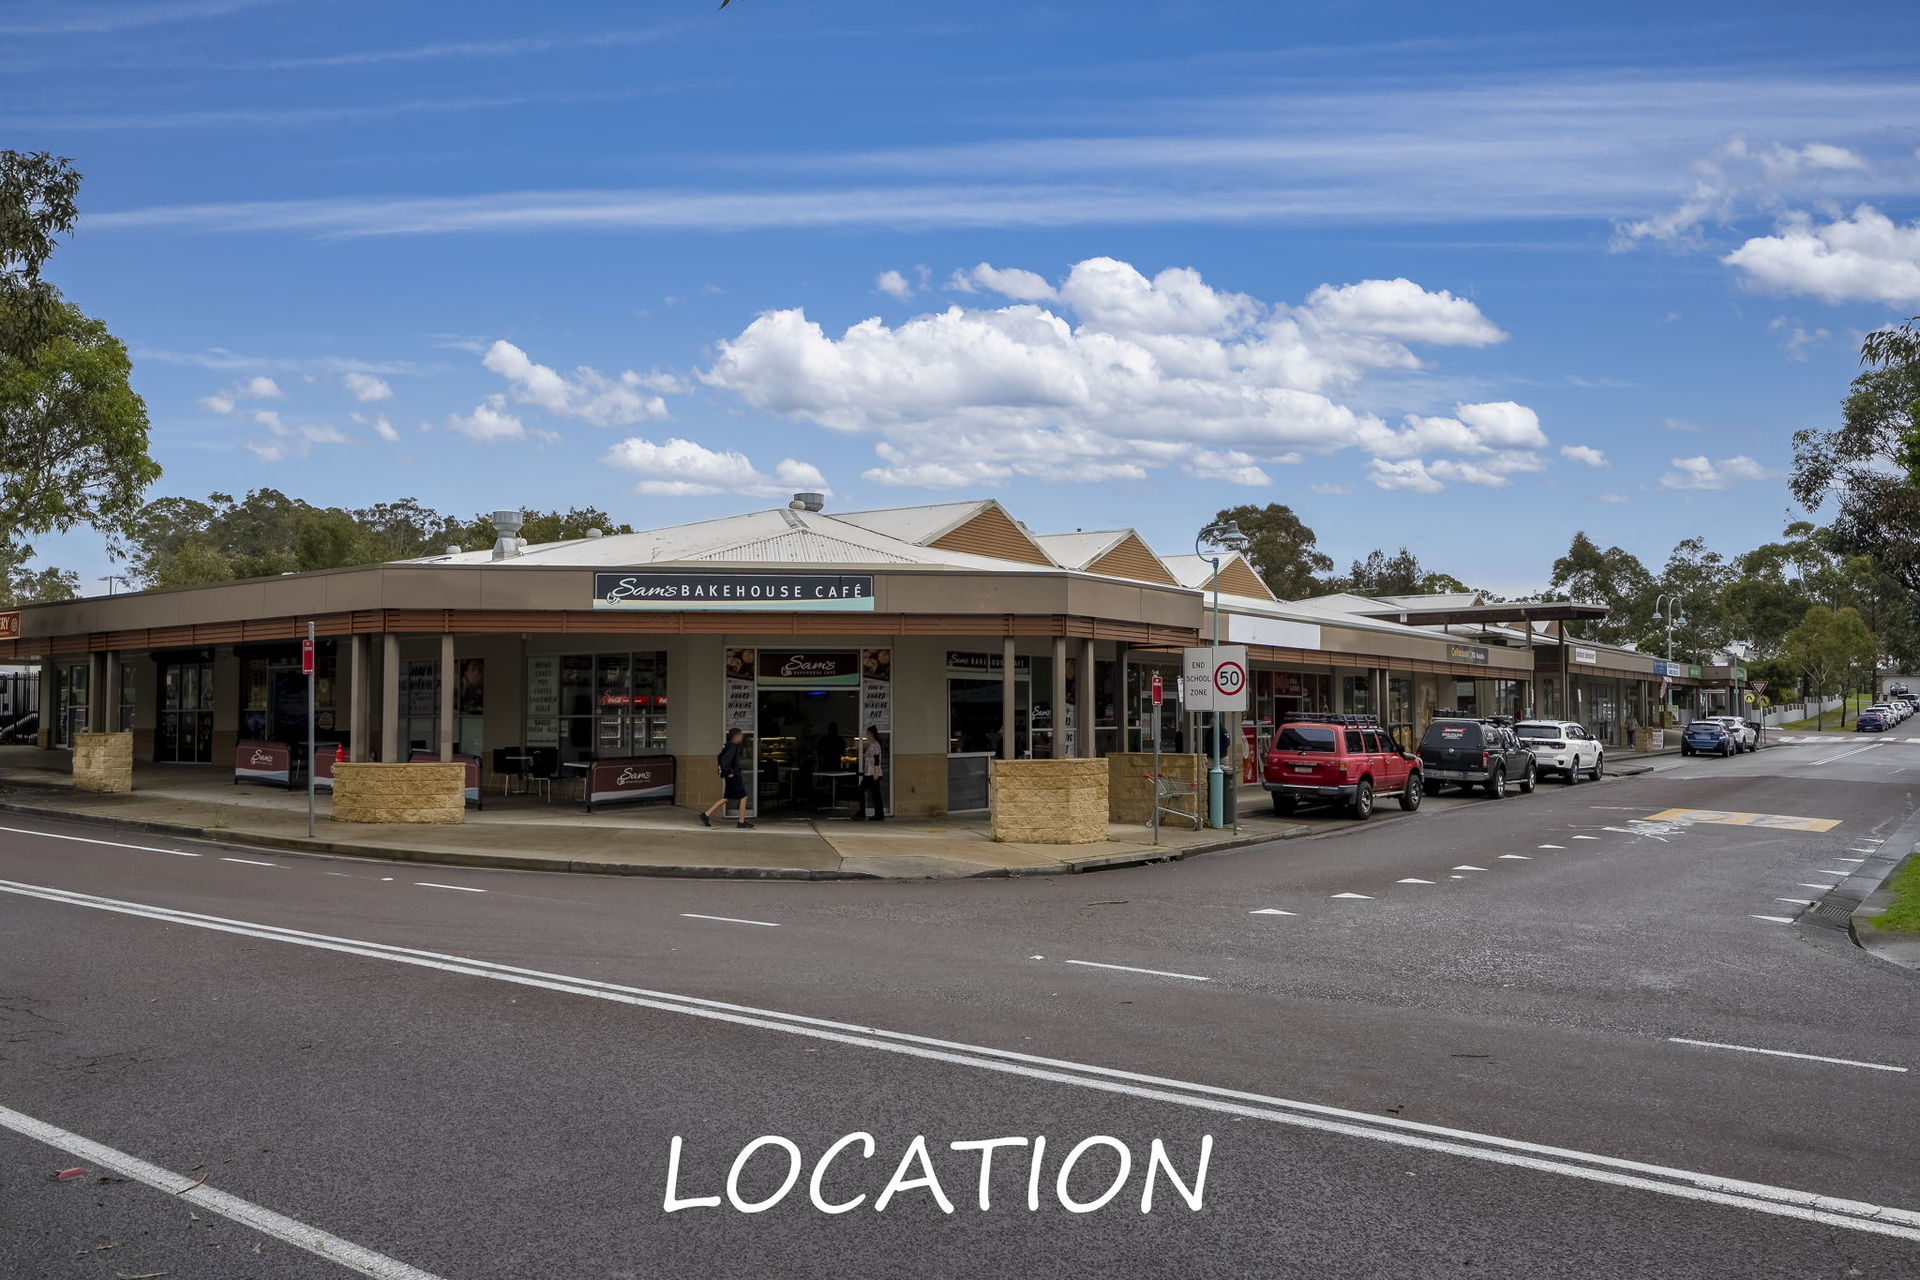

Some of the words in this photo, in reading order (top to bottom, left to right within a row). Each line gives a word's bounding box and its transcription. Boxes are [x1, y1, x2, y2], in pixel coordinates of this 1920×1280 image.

[611, 577, 678, 598] Sam's
[681, 584, 802, 598] BAKEHOUSE
[815, 583, 862, 598] CAFÉ
[785, 655, 836, 671] Sam's
[1191, 661, 1206, 669] END
[1220, 671, 1240, 686] 50
[1190, 688, 1208, 696] ZONE
[619, 767, 652, 780] Sam's
